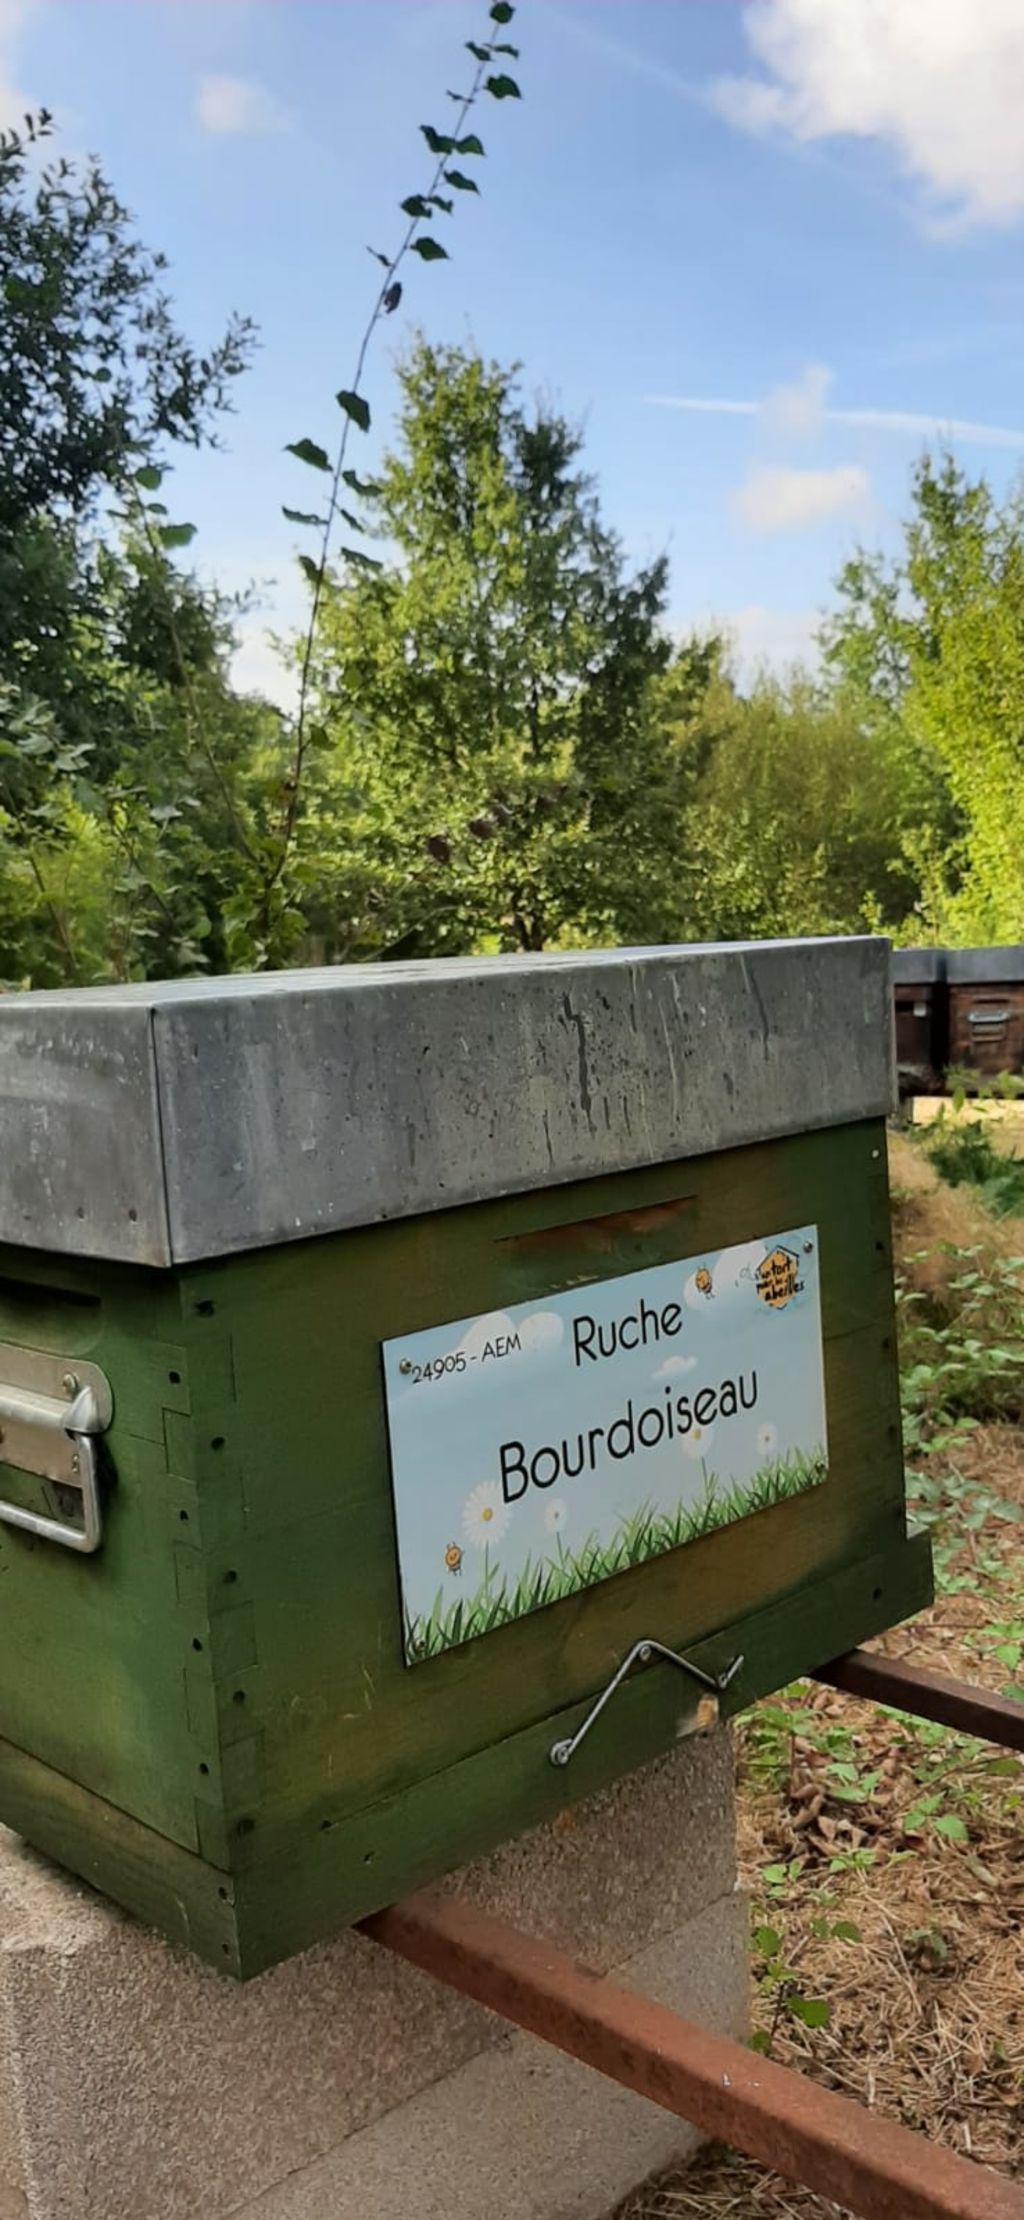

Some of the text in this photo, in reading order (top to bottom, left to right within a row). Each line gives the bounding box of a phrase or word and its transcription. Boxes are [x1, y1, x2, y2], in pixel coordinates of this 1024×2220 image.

[411, 1351, 467, 1384] 24905
[481, 1333, 522, 1362] AEM
[572, 1298, 682, 1366] Ruche
[499, 1370, 758, 1504] Bourdoiseau
